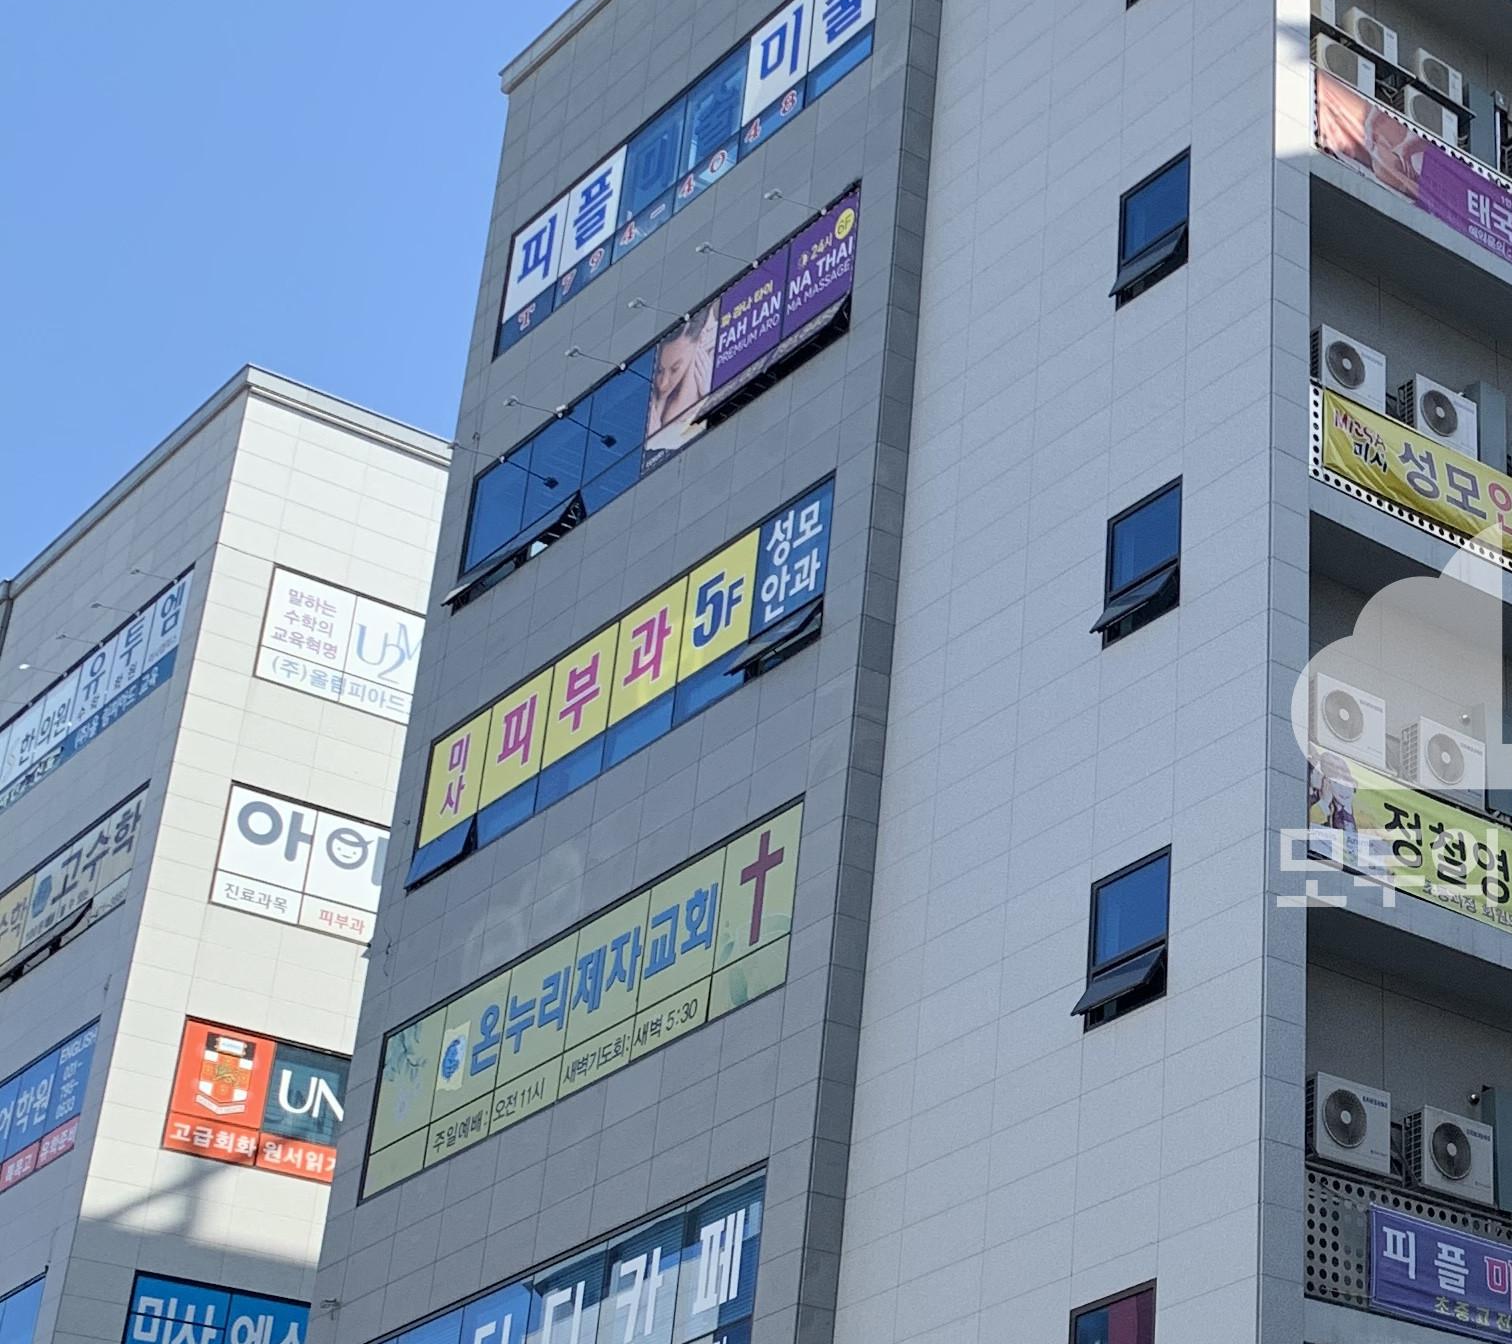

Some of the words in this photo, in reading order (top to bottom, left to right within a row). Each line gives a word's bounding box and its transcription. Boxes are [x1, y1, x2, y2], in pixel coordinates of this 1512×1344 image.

[716, 328, 758, 370] PREMIUM
[803, 259, 850, 304] MASSAGE
[718, 316, 747, 353] FAH
[816, 235, 854, 277] THAI
[766, 500, 822, 567] 성모
[286, 585, 338, 616] 말하는
[760, 554, 821, 623] 안과
[270, 623, 340, 661] 교육혁명
[284, 608, 334, 641] 수학의
[440, 732, 472, 818] 미사
[496, 607, 673, 768] 피부과
[692, 569, 744, 651] 5F
[19, 698, 71, 766] 한의원
[223, 881, 288, 915] 진료과목
[318, 906, 366, 936] 피부과
[469, 880, 719, 1081] 온누리제자교회
[633, 1015, 664, 1053] 새벽
[664, 996, 699, 1036] 5:30
[169, 1121, 258, 1157] 고급회화
